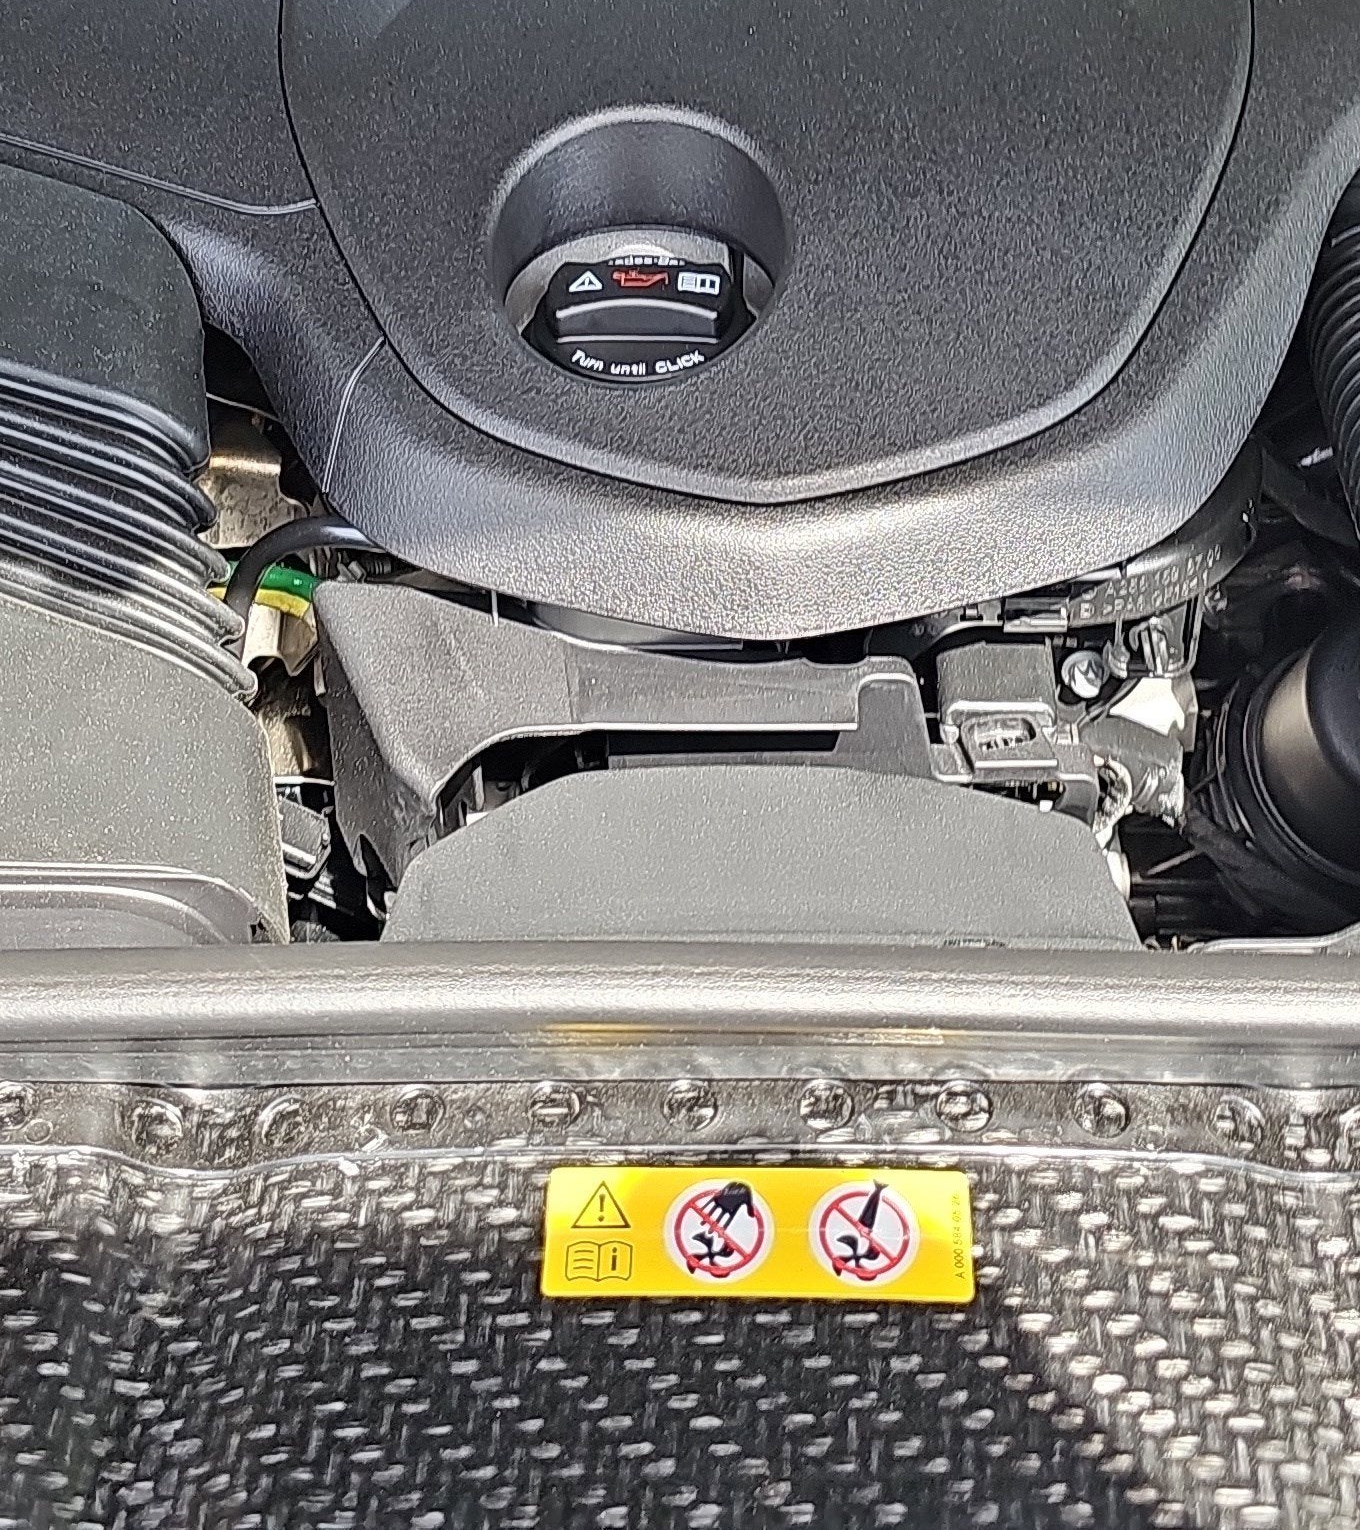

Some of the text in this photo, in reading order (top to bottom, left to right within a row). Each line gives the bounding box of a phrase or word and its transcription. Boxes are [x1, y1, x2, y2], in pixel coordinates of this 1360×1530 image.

[572, 349, 706, 375] Turn until CLICK
[953, 1248, 965, 1269] 000
[955, 1272, 965, 1280] A
